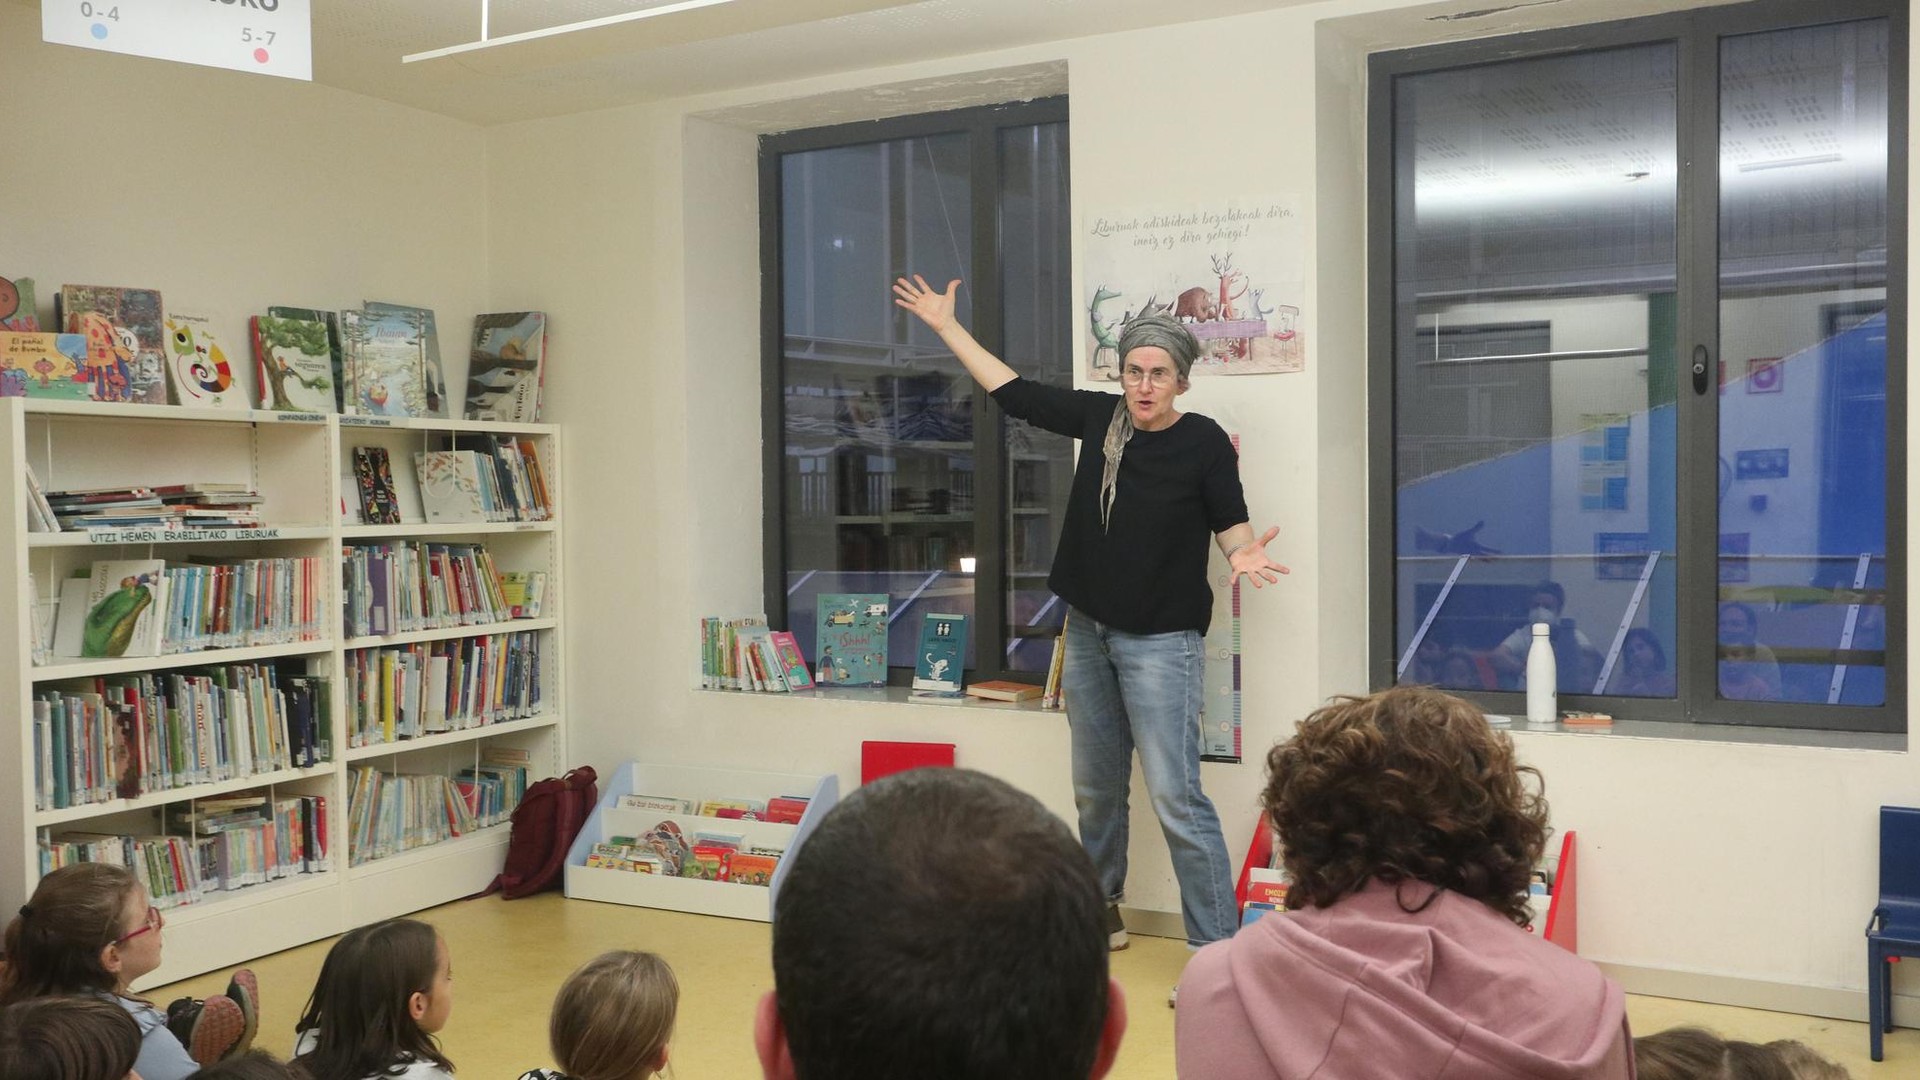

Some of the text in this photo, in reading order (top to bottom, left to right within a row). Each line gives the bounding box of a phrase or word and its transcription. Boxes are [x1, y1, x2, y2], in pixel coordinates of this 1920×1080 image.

[1090, 217, 1139, 238] Liburuak
[1143, 212, 1198, 229] adiskideak
[1201, 207, 1261, 229] bezalakoak
[1162, 236, 1175, 250] ez
[1180, 229, 1201, 243] dira
[90, 529, 279, 543] UTZI HEMEN ERABILITAKO LIBURUAK
